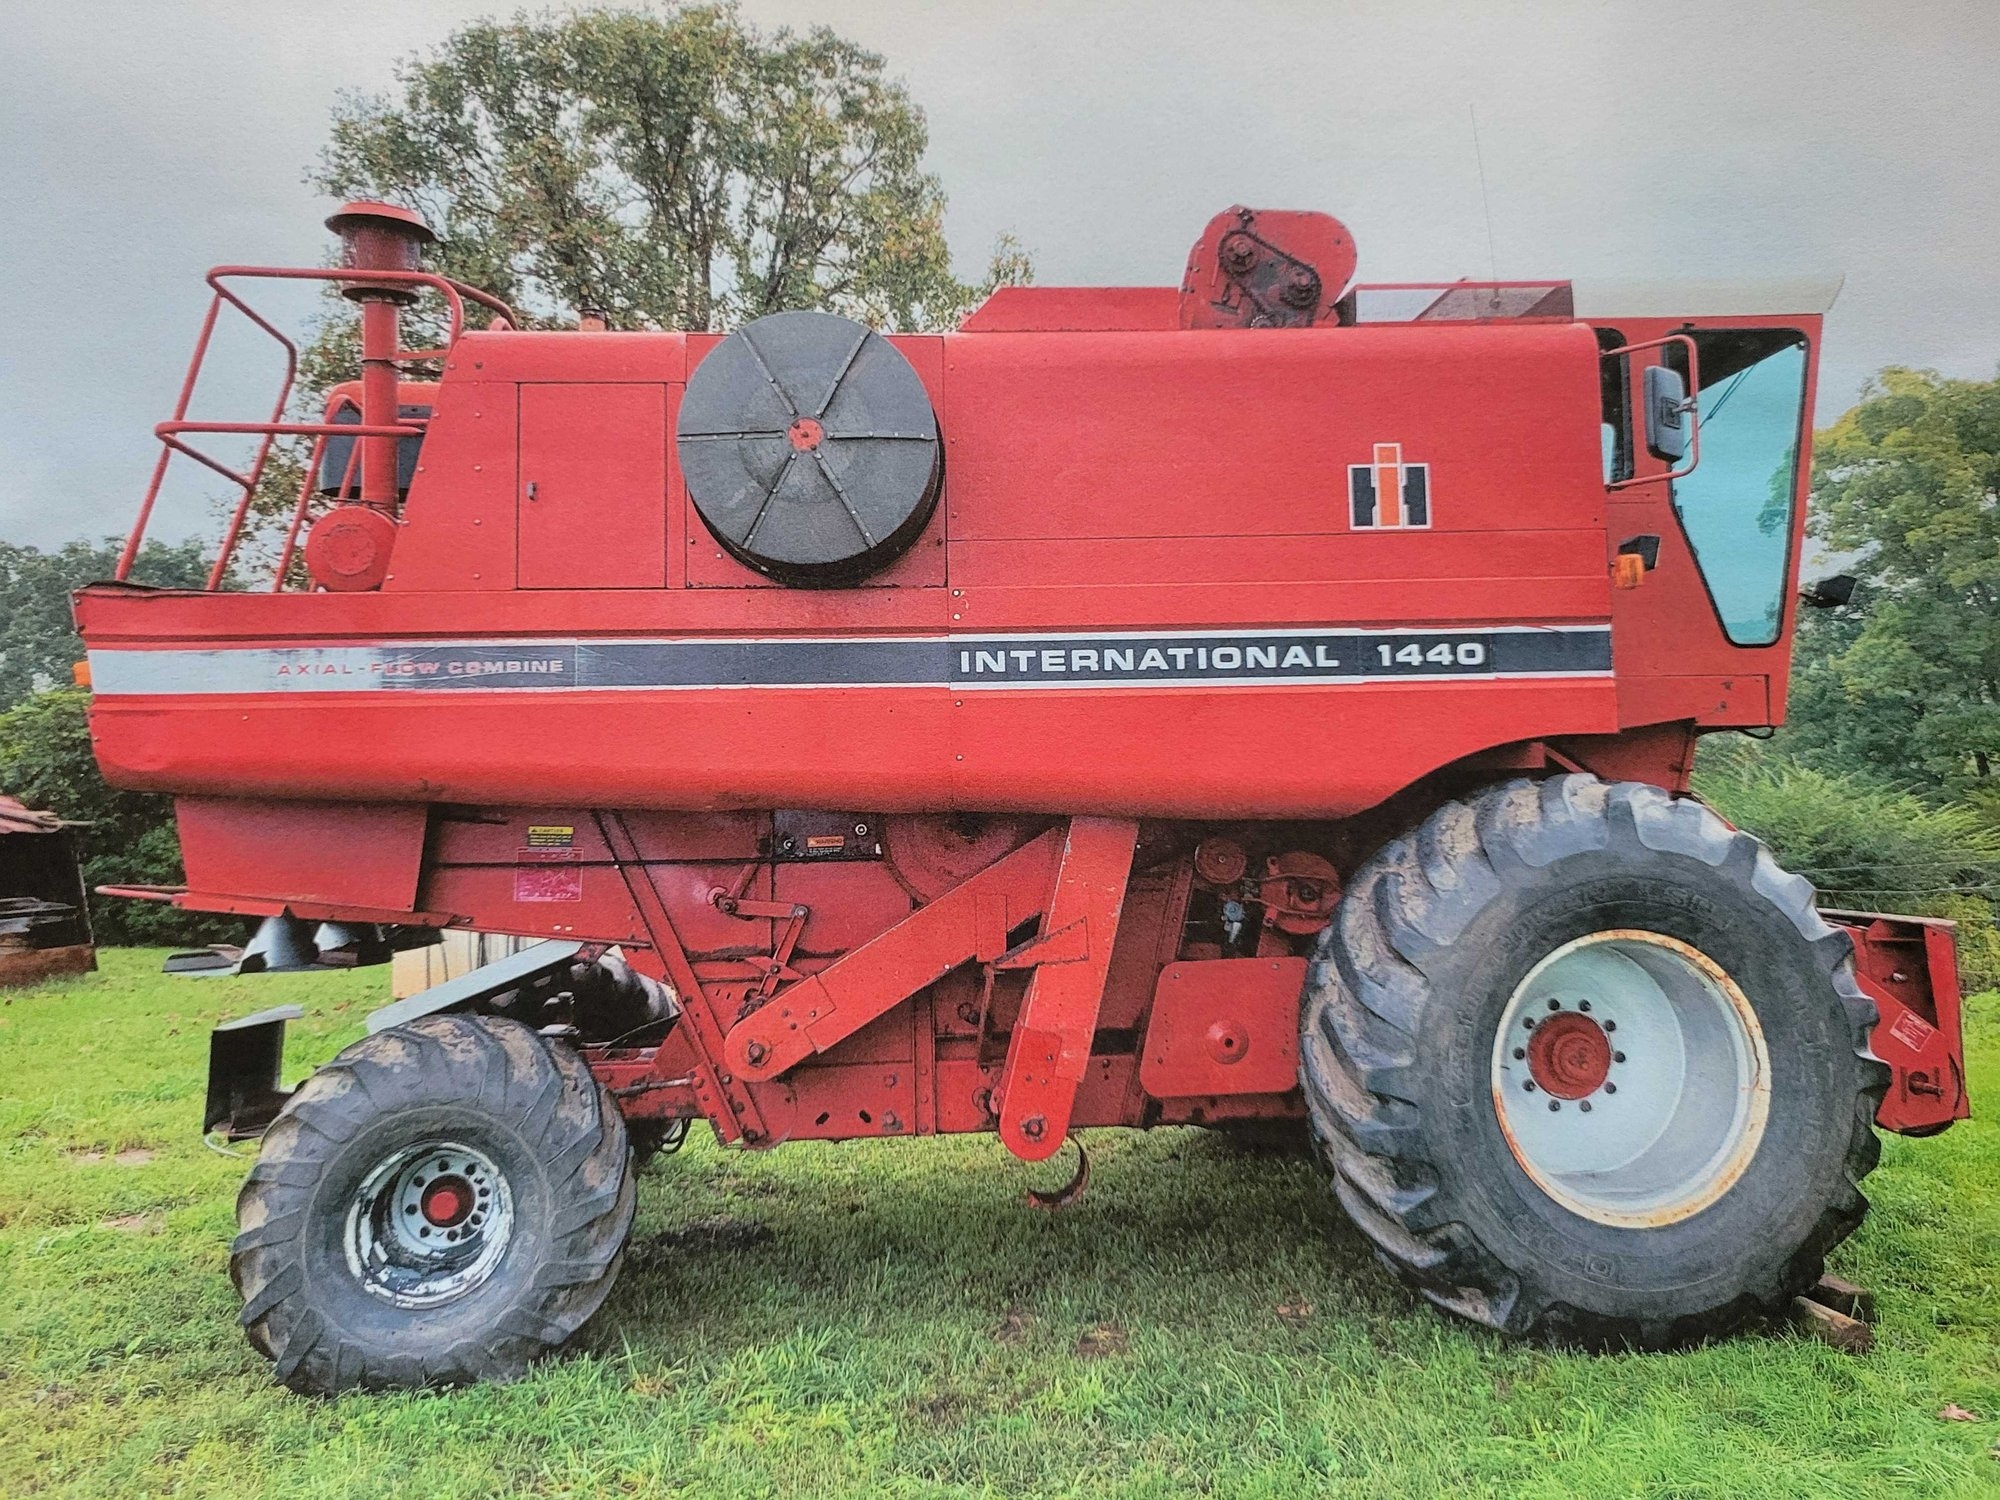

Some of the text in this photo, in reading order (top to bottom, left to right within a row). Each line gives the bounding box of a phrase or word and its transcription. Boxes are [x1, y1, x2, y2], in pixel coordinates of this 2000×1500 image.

[447, 660, 563, 674] COMBINE
[960, 643, 1484, 673] INTERNATIONAL 1440
